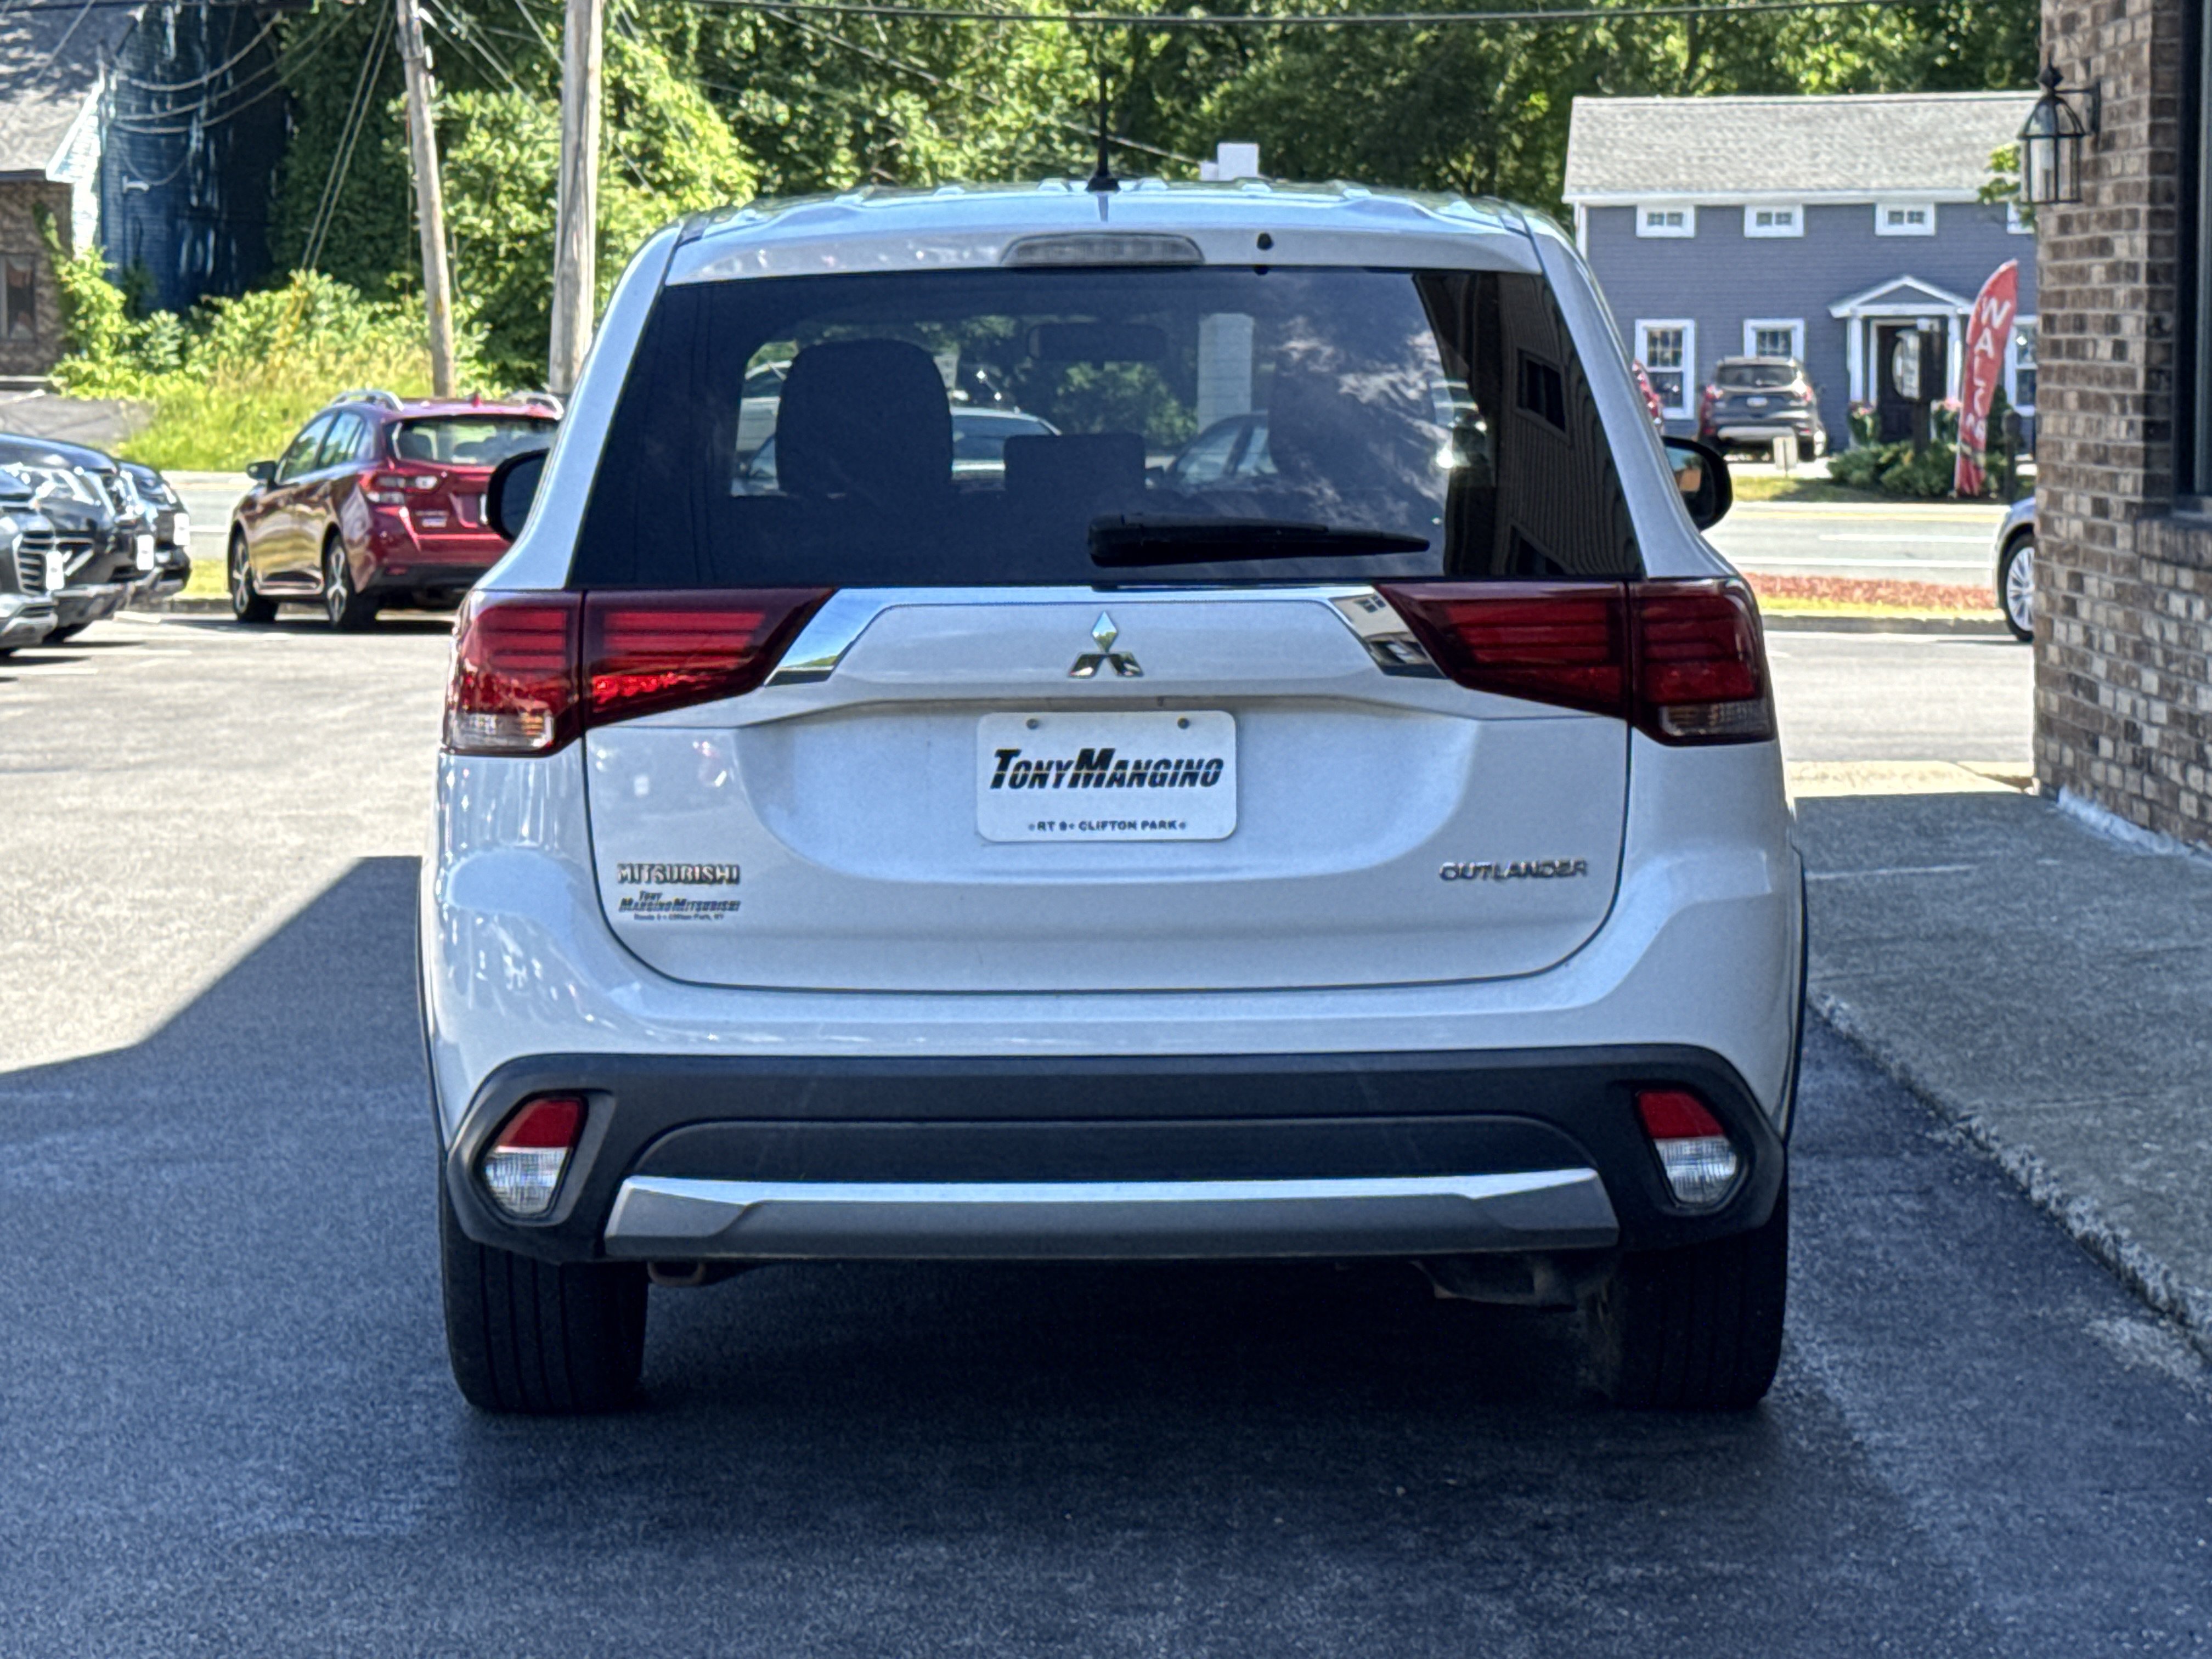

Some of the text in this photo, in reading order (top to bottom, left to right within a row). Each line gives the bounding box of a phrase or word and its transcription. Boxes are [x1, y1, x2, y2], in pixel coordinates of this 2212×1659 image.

[1037, 821, 1055, 831] RT
[1078, 820, 1137, 831] CLIFTON
[1141, 820, 1178, 831] PARK
[617, 862, 741, 885] MITSUBISHI
[1438, 860, 1589, 881] OUTLANDER
